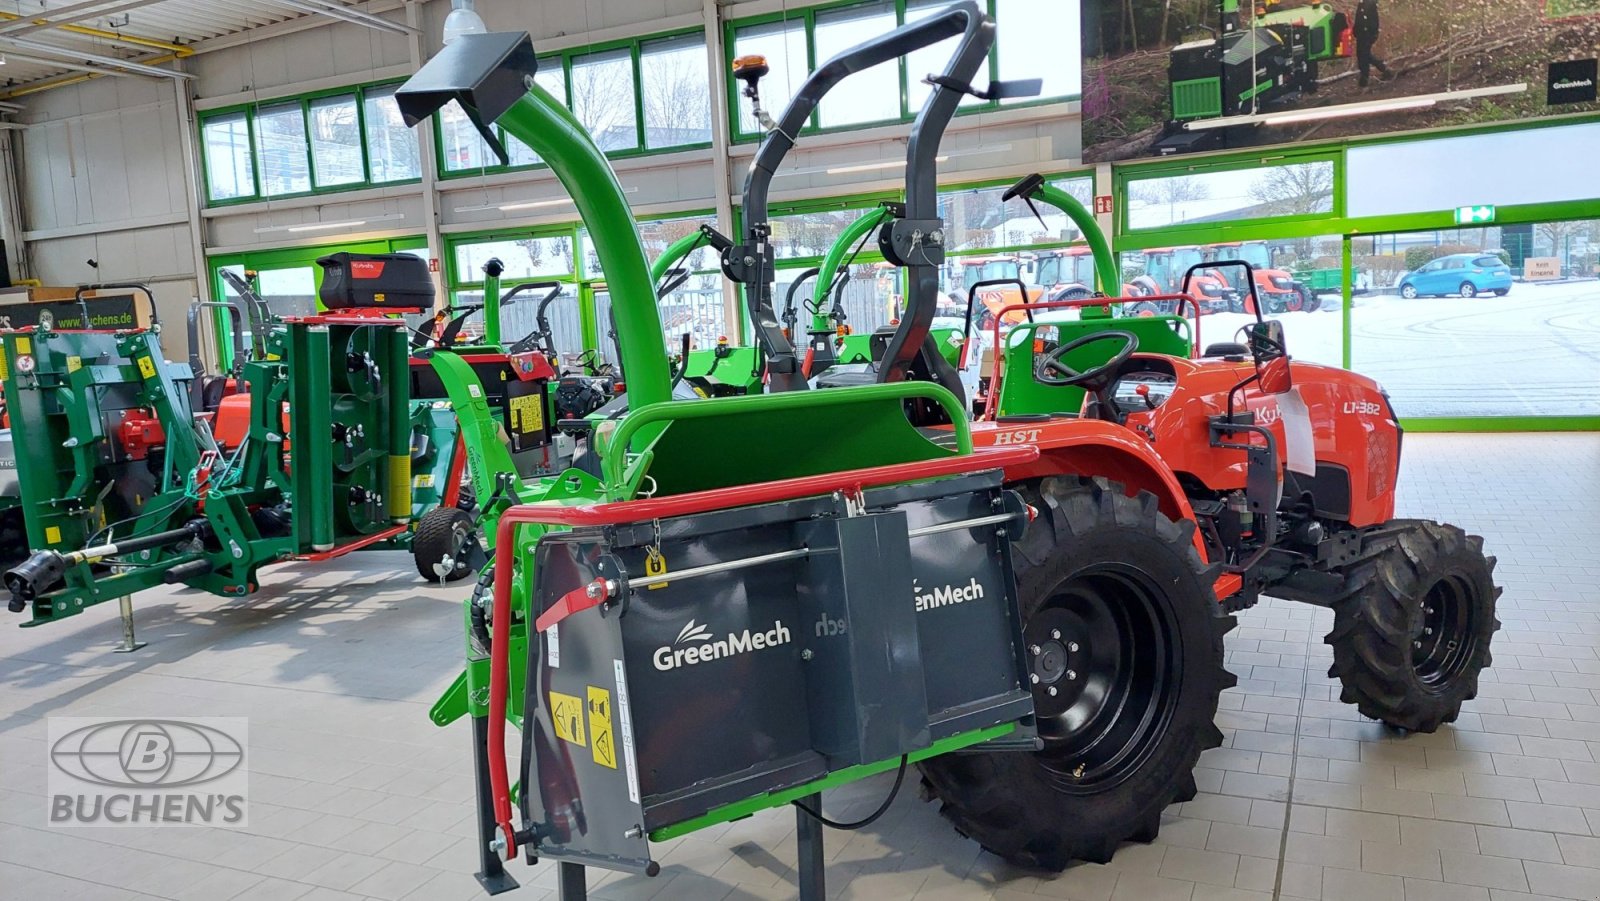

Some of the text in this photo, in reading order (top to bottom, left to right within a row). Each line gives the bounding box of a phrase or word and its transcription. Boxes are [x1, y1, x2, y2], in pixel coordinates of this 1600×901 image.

[1553, 78, 1592, 89] GreenMech
[58, 312, 132, 328] www.uchens.de
[993, 429, 1042, 446] HST
[468, 446, 484, 496] GreenMech
[915, 577, 984, 612] enMech
[653, 620, 791, 671] GreenMech
